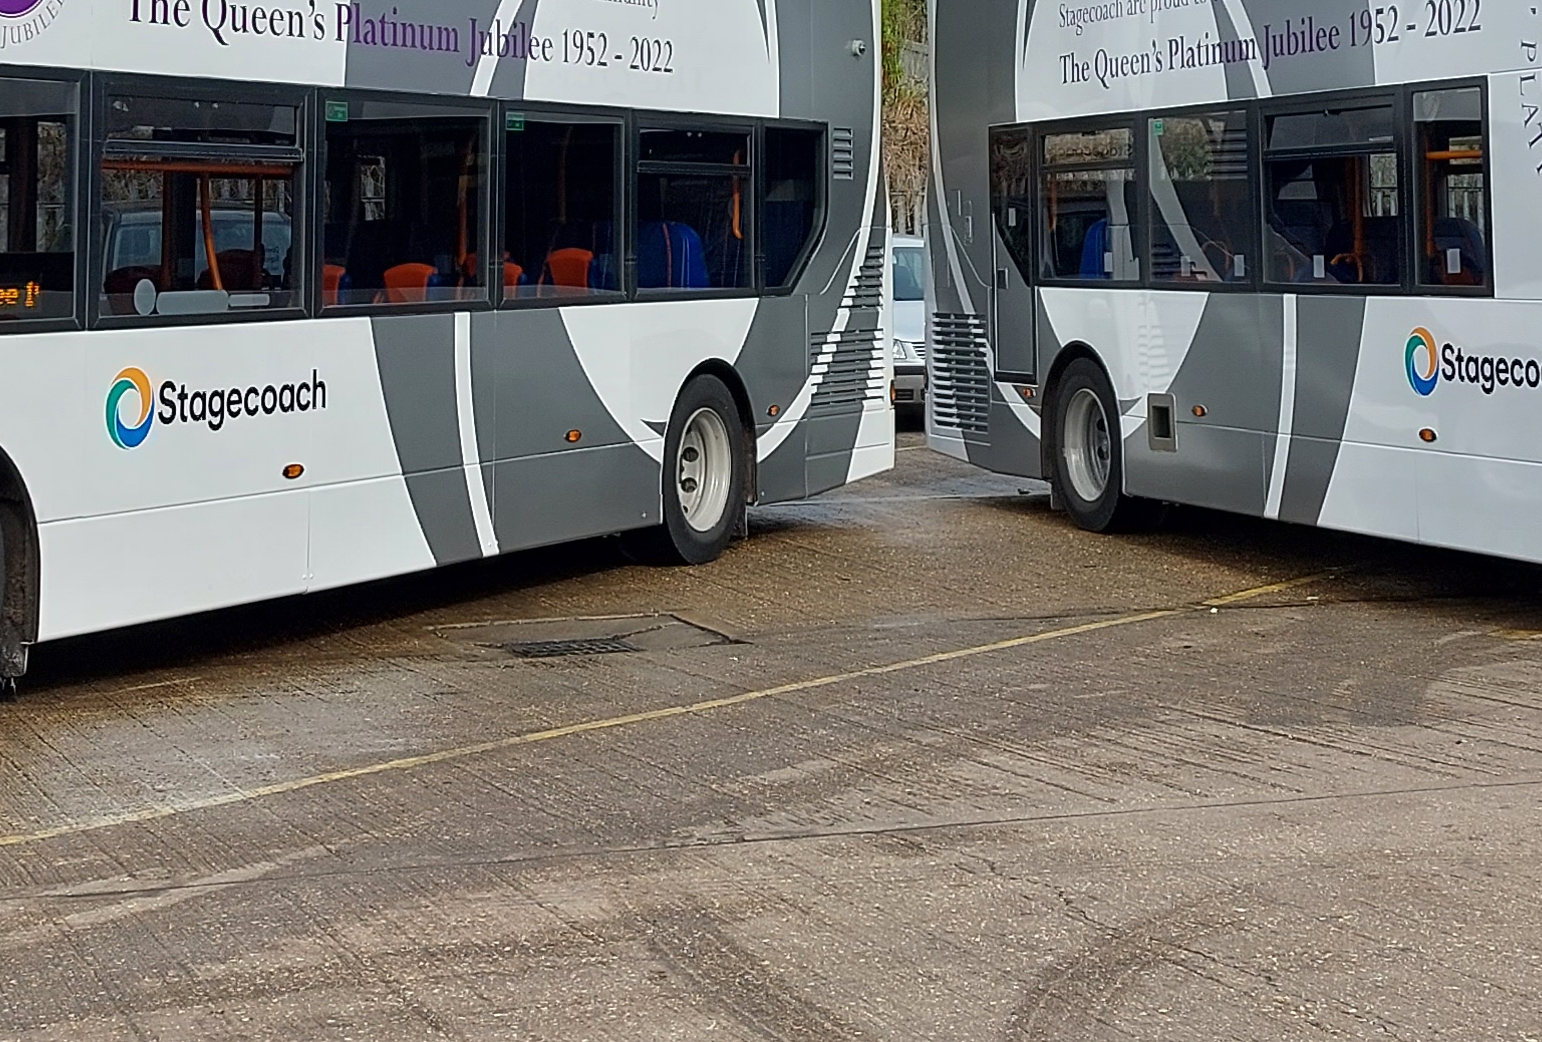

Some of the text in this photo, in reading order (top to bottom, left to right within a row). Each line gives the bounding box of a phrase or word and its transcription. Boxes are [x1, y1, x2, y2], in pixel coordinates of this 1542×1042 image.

[334, 2, 460, 53] Platinum
[466, 18, 553, 67] Jubilee
[562, 28, 608, 67] 1952
[630, 36, 673, 74] 2022
[1059, 52, 1090, 84] The
[1095, 39, 1163, 89] Queen's
[1168, 31, 1257, 71] Platinum
[1262, 16, 1341, 70] Jubilee
[1348, 5, 1400, 47] 1952
[157, 369, 326, 431] Stagecoach
